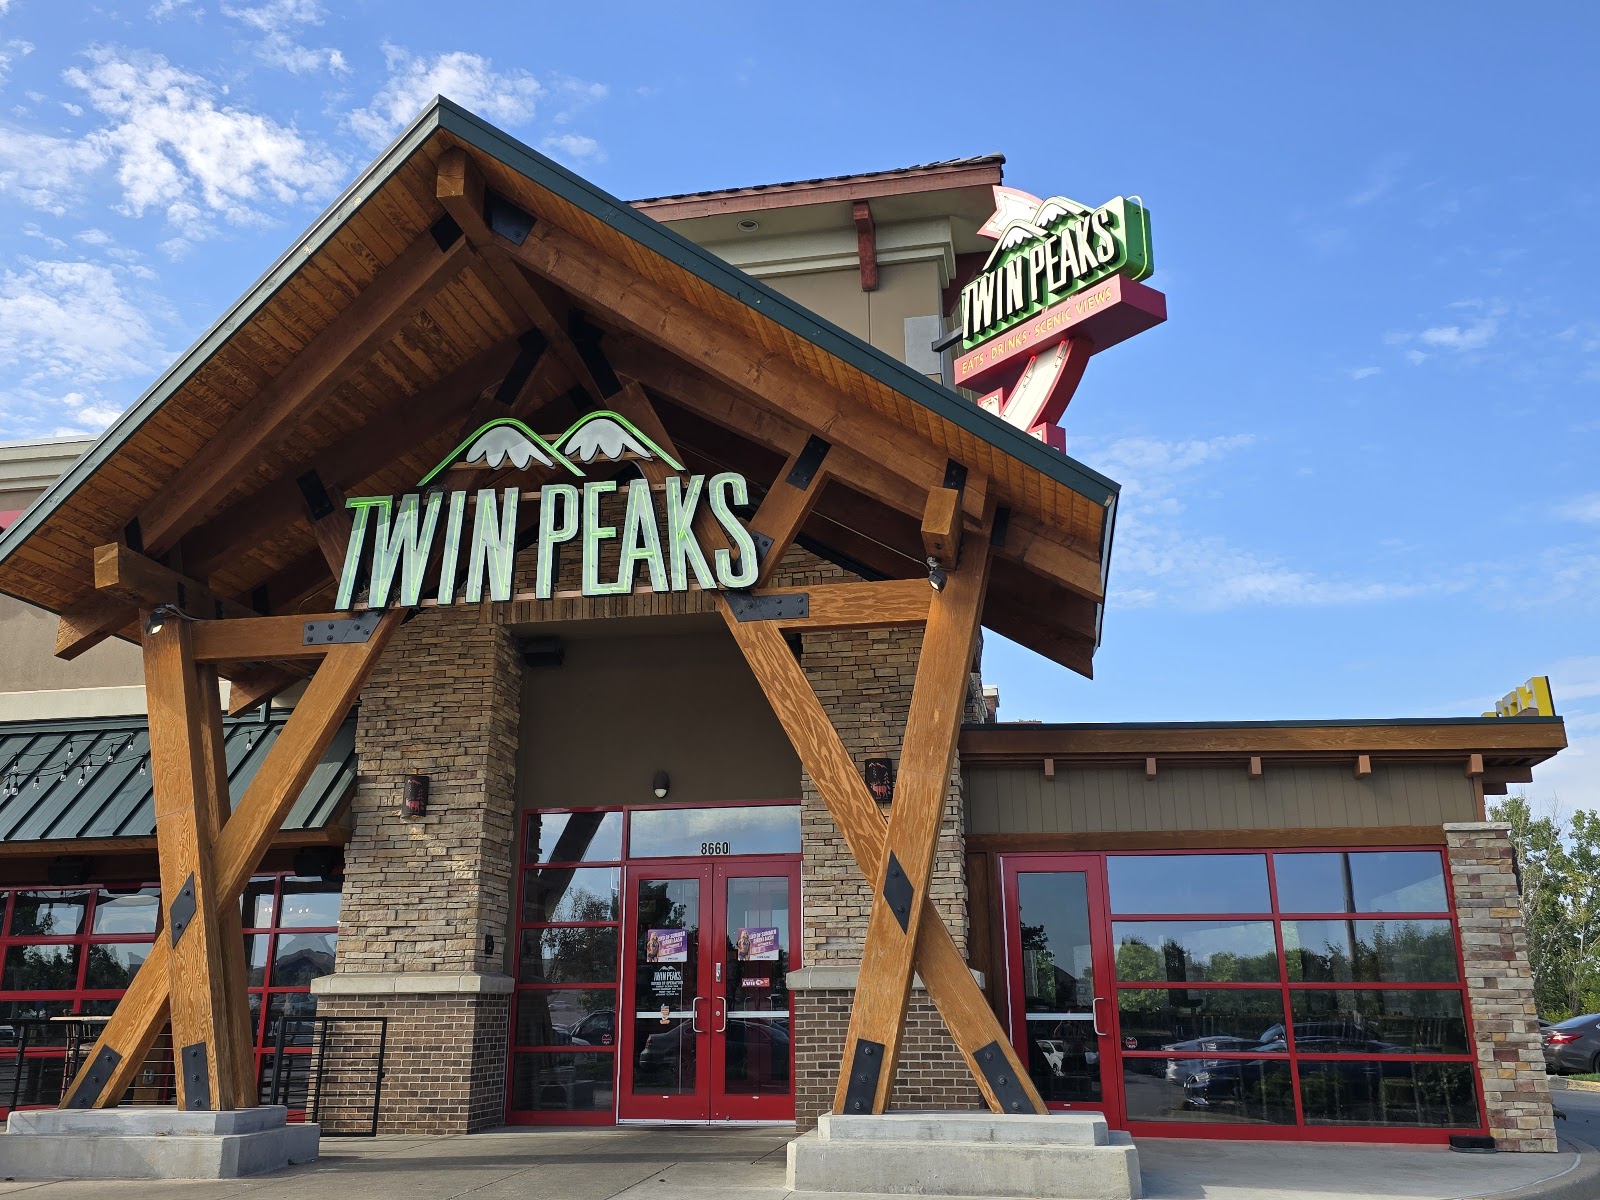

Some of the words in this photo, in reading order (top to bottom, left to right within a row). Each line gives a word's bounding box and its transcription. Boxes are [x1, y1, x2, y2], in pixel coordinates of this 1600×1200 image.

[962, 255, 1026, 340] TWIN
[1029, 208, 1117, 302] PEAKS
[962, 352, 984, 374] EATS
[991, 330, 1027, 359] DRINKS
[1034, 308, 1072, 336] SCENIC
[1076, 287, 1112, 316] VIEWS
[335, 487, 519, 610] TWIN
[535, 472, 759, 599] PEAKS
[701, 842, 728, 855] 8660
[654, 971, 667, 981] TWIN
[667, 971, 681, 981] PEAKS
